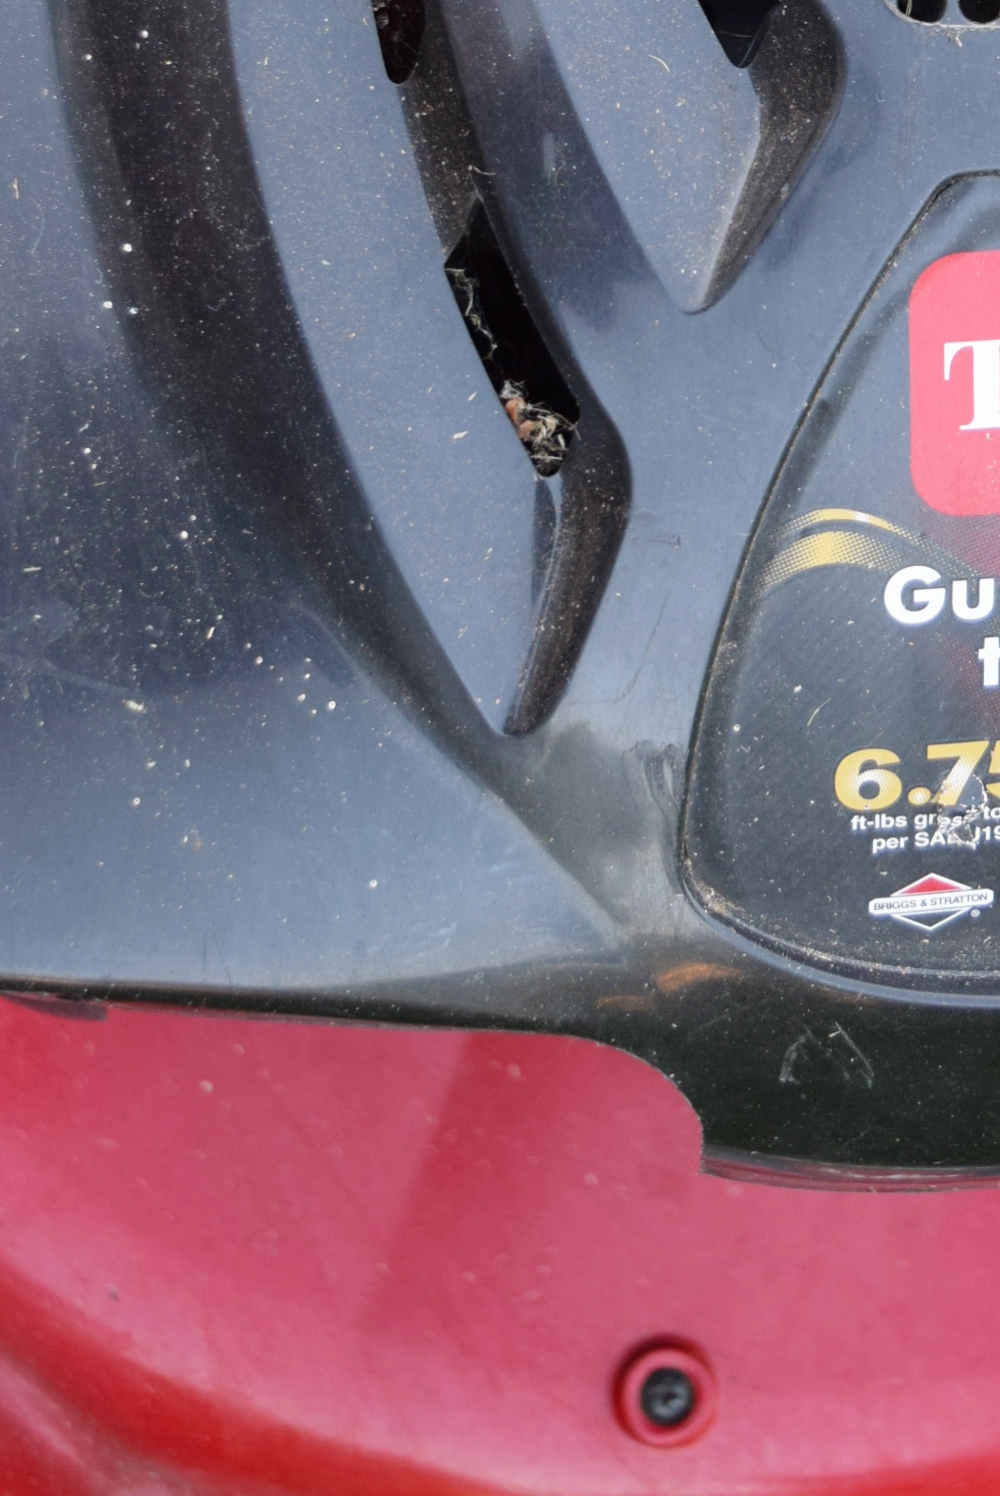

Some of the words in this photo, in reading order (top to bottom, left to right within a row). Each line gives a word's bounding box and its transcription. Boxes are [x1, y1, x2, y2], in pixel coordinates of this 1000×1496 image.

[851, 813, 907, 831] ft-lbs
[872, 835, 908, 853] per
[873, 899, 917, 911] BRIGGS
[930, 893, 988, 906] STRATTON
